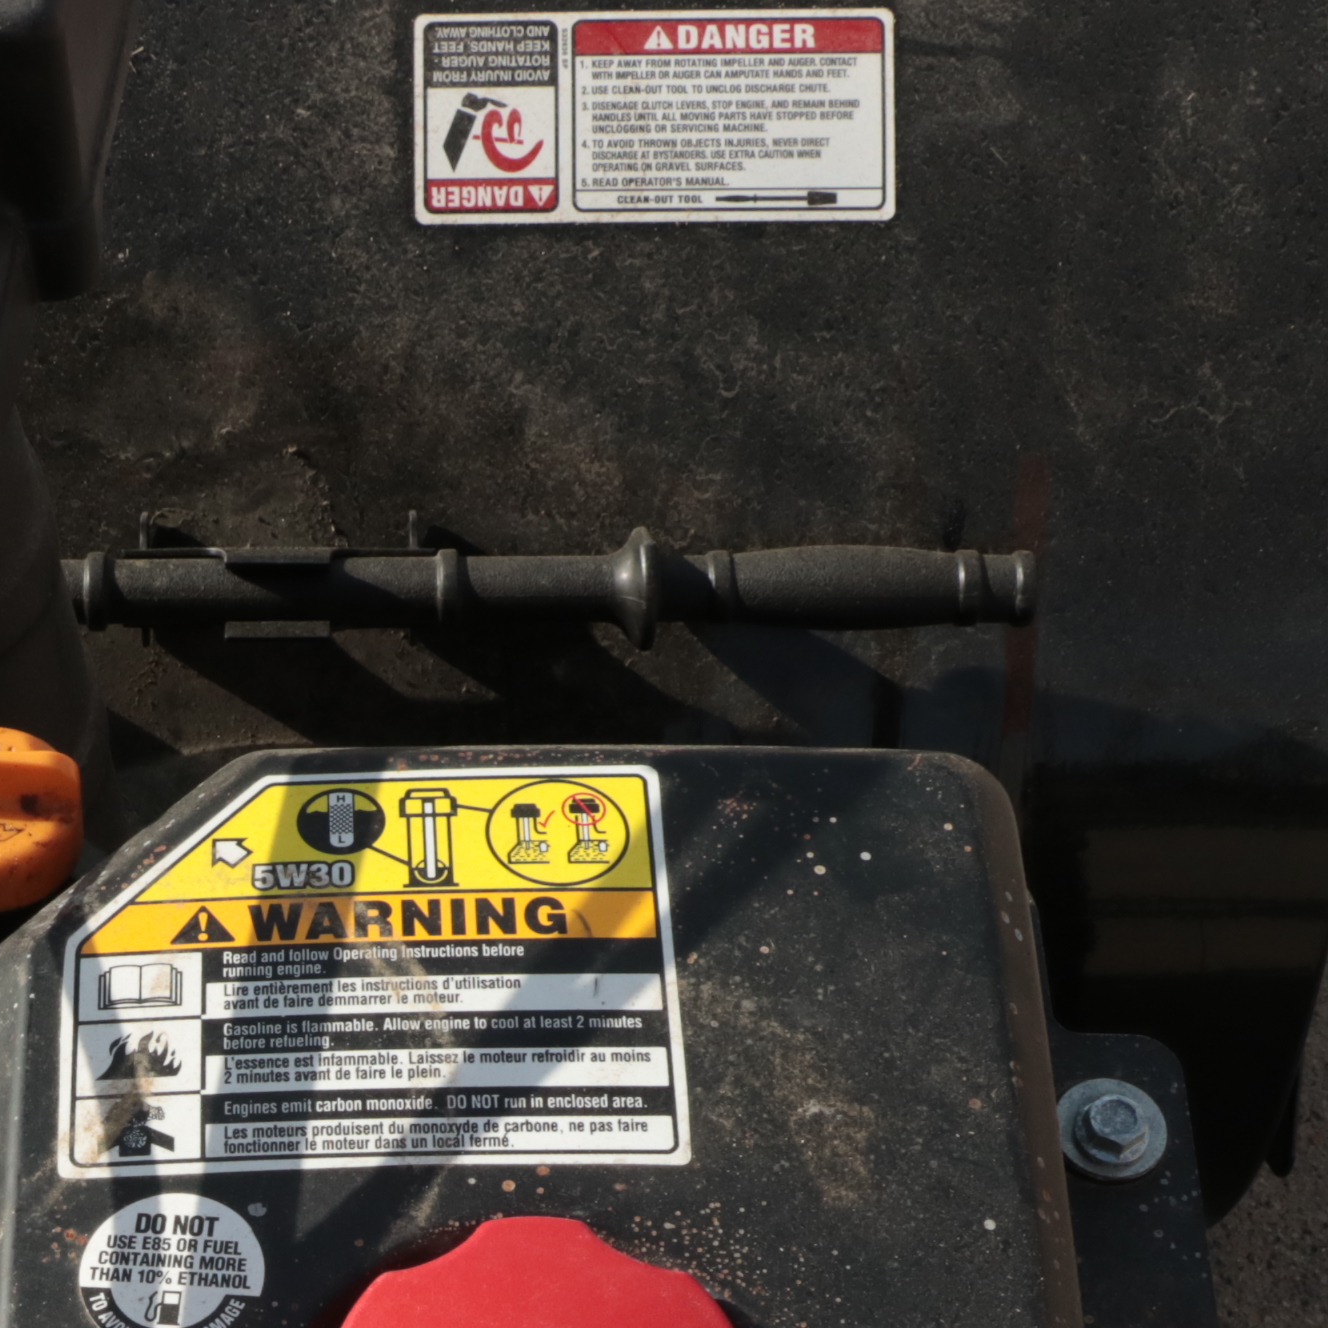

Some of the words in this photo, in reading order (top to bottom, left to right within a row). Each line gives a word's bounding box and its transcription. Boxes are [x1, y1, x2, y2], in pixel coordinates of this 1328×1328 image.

[469, 26, 524, 38] CLOTHING
[527, 26, 550, 37] AND
[678, 24, 815, 49] DANGER
[433, 42, 464, 52] FEET
[517, 40, 550, 52] KEEP
[442, 56, 485, 67] AUGER
[489, 55, 550, 67] ROTATING
[580, 60, 588, 68] 1.
[592, 59, 614, 68] KEEP
[617, 60, 642, 68] AWAY
[645, 59, 671, 68] FROM
[674, 58, 718, 67] ROTATING
[720, 58, 764, 67] IMPELLER
[768, 58, 786, 66] AND
[788, 58, 816, 66] AUGER.
[820, 57, 858, 66] CONTACT
[433, 71, 467, 82] FROM
[470, 70, 511, 82] INJURY
[515, 70, 550, 81] AVOID
[592, 70, 613, 80] WITH
[615, 70, 656, 80] IMPELLER
[658, 70, 670, 79] OR
[672, 70, 701, 79] AUGER
[704, 70, 722, 79] CAN
[724, 69, 770, 79] AMPUTATE
[773, 69, 802, 78] HANDS
[806, 69, 824, 78] AND
[826, 69, 850, 78] FEET.
[582, 86, 590, 94] 2.
[592, 85, 609, 94] USE
[612, 84, 662, 94] CLEAN-OUT
[666, 84, 688, 94] TOOL
[692, 84, 702, 93] TO
[706, 84, 742, 93] UNCLOG
[745, 84, 796, 93] DISCHARGE
[799, 84, 830, 93] CHUTE.
[582, 178, 590, 187] 5.
[592, 178, 619, 186] READ
[622, 178, 682, 186] OPERATOR'S
[686, 178, 730, 186] MANUAL.
[432, 186, 523, 207] DANGER
[617, 194, 674, 204] CLEAN-OUT
[678, 194, 703, 203] TOOL
[252, 862, 355, 890] 5W30
[249, 897, 569, 942] WARNING
[223, 951, 256, 964] Read
[261, 952, 284, 963] and
[289, 948, 328, 962] follow
[334, 947, 397, 962] Operating
[402, 944, 478, 958] Instructions
[482, 943, 524, 957] before
[223, 964, 272, 978] running
[277, 963, 326, 976] engine.
[224, 984, 248, 996] Lire
[254, 981, 333, 995] entièrement
[337, 980, 356, 992] les
[362, 978, 437, 992] instructions
[443, 977, 521, 989] d'utilisation
[224, 997, 259, 1010] avant
[264, 996, 279, 1009] de
[284, 995, 313, 1007] faire
[318, 993, 392, 1007] demmarrer
[397, 993, 408, 1004] le
[414, 992, 463, 1004] moteur.
[224, 1022, 281, 1036] Gasoline
[287, 1022, 297, 1034] is
[302, 1019, 378, 1033] flammable.
[384, 1018, 420, 1031] Allow
[425, 1018, 470, 1032] engine
[474, 1017, 487, 1029] to
[491, 1016, 519, 1029] cool
[523, 1017, 536, 1028] at
[540, 1016, 572, 1028] least
[576, 1016, 584, 1028] 2
[589, 1016, 642, 1028] minutes
[224, 1037, 265, 1049] before
[270, 1035, 334, 1049] refueling.
[224, 1057, 289, 1070] L'essence
[295, 1055, 313, 1068] est
[318, 1053, 403, 1067] infammable.
[409, 1052, 458, 1064] Laissez
[463, 1051, 475, 1063] le
[480, 1051, 526, 1063] moteur
[531, 1050, 586, 1062] refroidir
[590, 1051, 605, 1062] au
[611, 1050, 651, 1062] moins
[224, 1072, 232, 1084] 2
[237, 1070, 289, 1083] minutes
[295, 1069, 331, 1082] avant
[336, 1068, 350, 1080] de
[356, 1067, 385, 1079] faire
[391, 1066, 402, 1078] le
[408, 1066, 446, 1081] plein.
[224, 1101, 277, 1117] Engines
[282, 1099, 312, 1113] emit
[316, 1097, 362, 1112] carbon
[366, 1096, 438, 1110] monoxide.
[447, 1095, 467, 1109] DO
[471, 1094, 500, 1109] NOT
[504, 1097, 526, 1108] run
[530, 1095, 543, 1108] in
[547, 1094, 608, 1108] enclosed
[612, 1096, 647, 1108] area.
[224, 1127, 247, 1140] Les
[252, 1125, 306, 1138] moteurs
[312, 1122, 383, 1139] produisent
[389, 1121, 404, 1134] du
[410, 1120, 478, 1136] monoxyde
[484, 1120, 499, 1132] de
[504, 1119, 563, 1134] carbone,
[569, 1121, 584, 1132] ne
[590, 1121, 612, 1134] pas
[618, 1119, 648, 1132] faire
[224, 1140, 300, 1154] fonctionner
[305, 1139, 316, 1151] le
[322, 1138, 369, 1150] moteur
[375, 1136, 406, 1149] dans
[412, 1137, 427, 1148] un
[433, 1135, 464, 1148] local
[470, 1133, 514, 1148] fermé.
[135, 1213, 166, 1234] DO
[173, 1216, 219, 1237] NOT
[107, 1235, 136, 1249] USE
[142, 1238, 171, 1251] E85
[177, 1238, 197, 1253] OR
[203, 1240, 242, 1255] FUEL
[98, 1251, 194, 1269] CONTAINING
[199, 1257, 247, 1272] MORE
[90, 1267, 132, 1282] THAN
[138, 1270, 172, 1285] 10%
[178, 1274, 251, 1289] ETHANOL
[89, 1293, 108, 1311] TO
